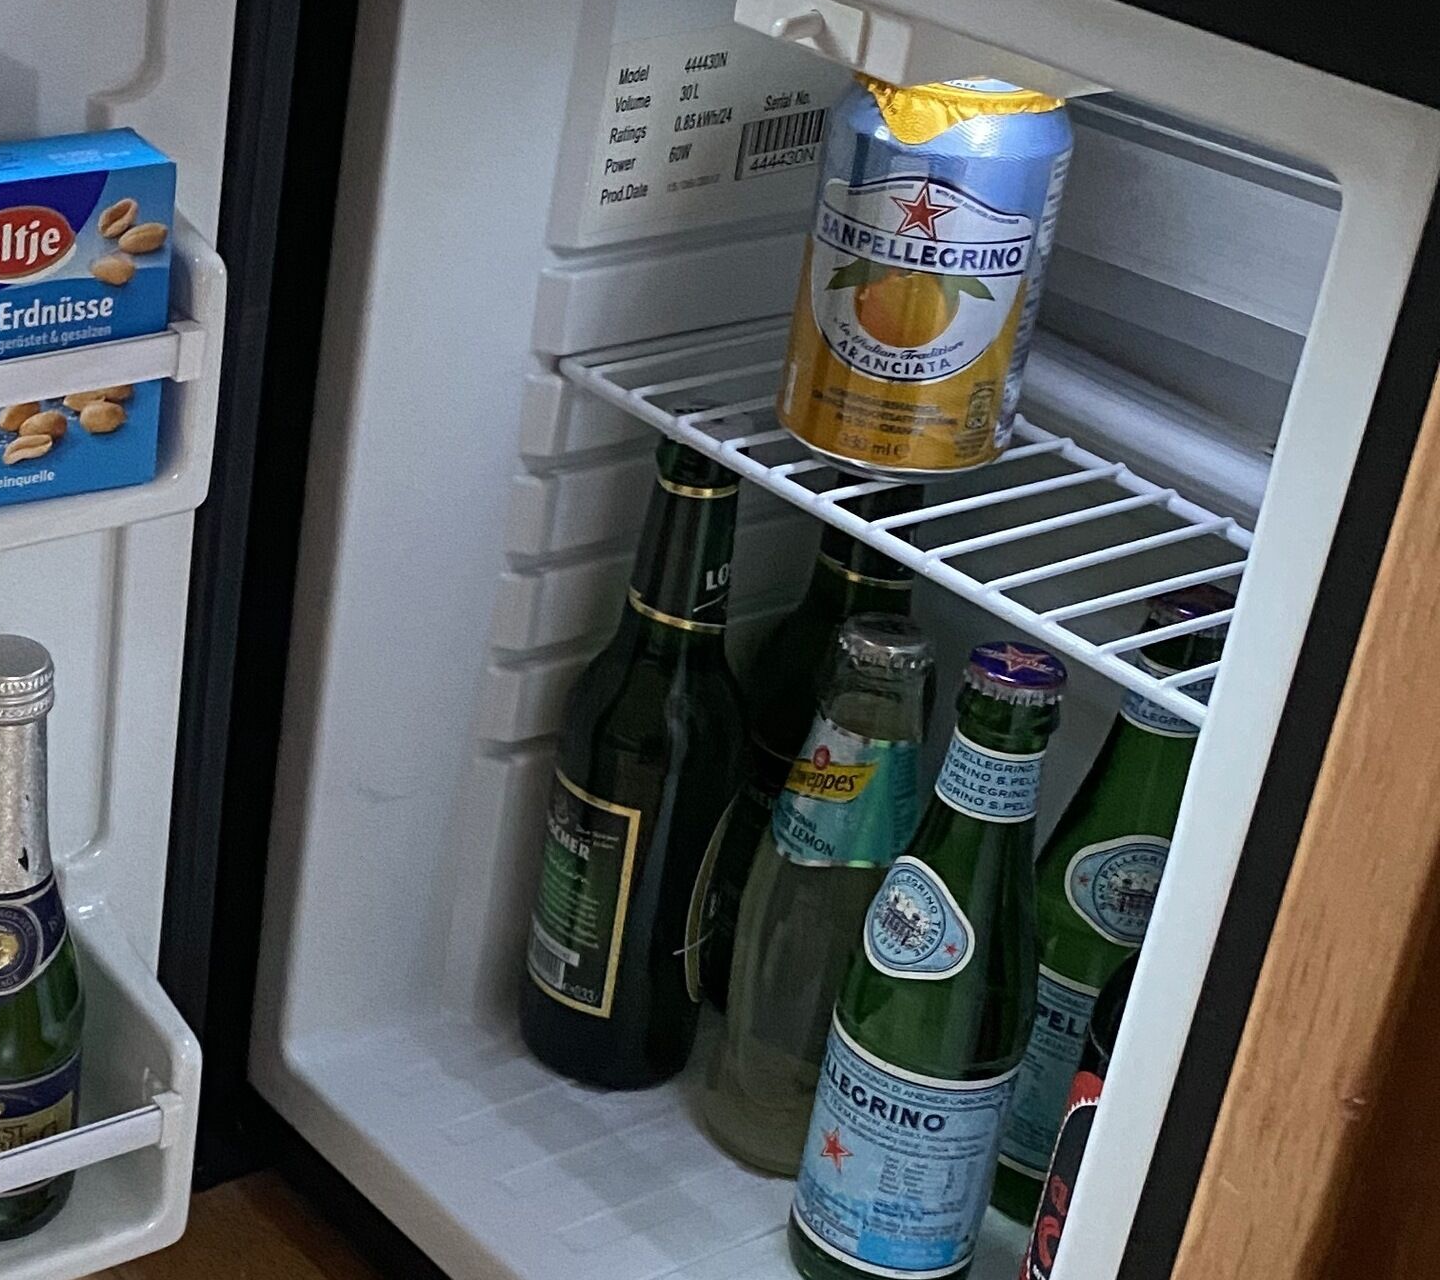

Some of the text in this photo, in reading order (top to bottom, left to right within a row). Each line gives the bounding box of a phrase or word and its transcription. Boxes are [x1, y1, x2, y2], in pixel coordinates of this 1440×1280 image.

[619, 65, 650, 85] Model
[615, 94, 651, 113] Volume
[763, 92, 792, 112] Serial
[609, 124, 647, 145] Ratings
[604, 157, 636, 176] Power
[600, 182, 649, 207] Prod.Date
[822, 212, 1022, 271] SANPELLEGRINO
[49, 327, 59, 343] &
[60, 323, 112, 347] gesalzen
[837, 339, 951, 375] ARANCIATA
[791, 824, 836, 858] LEMON
